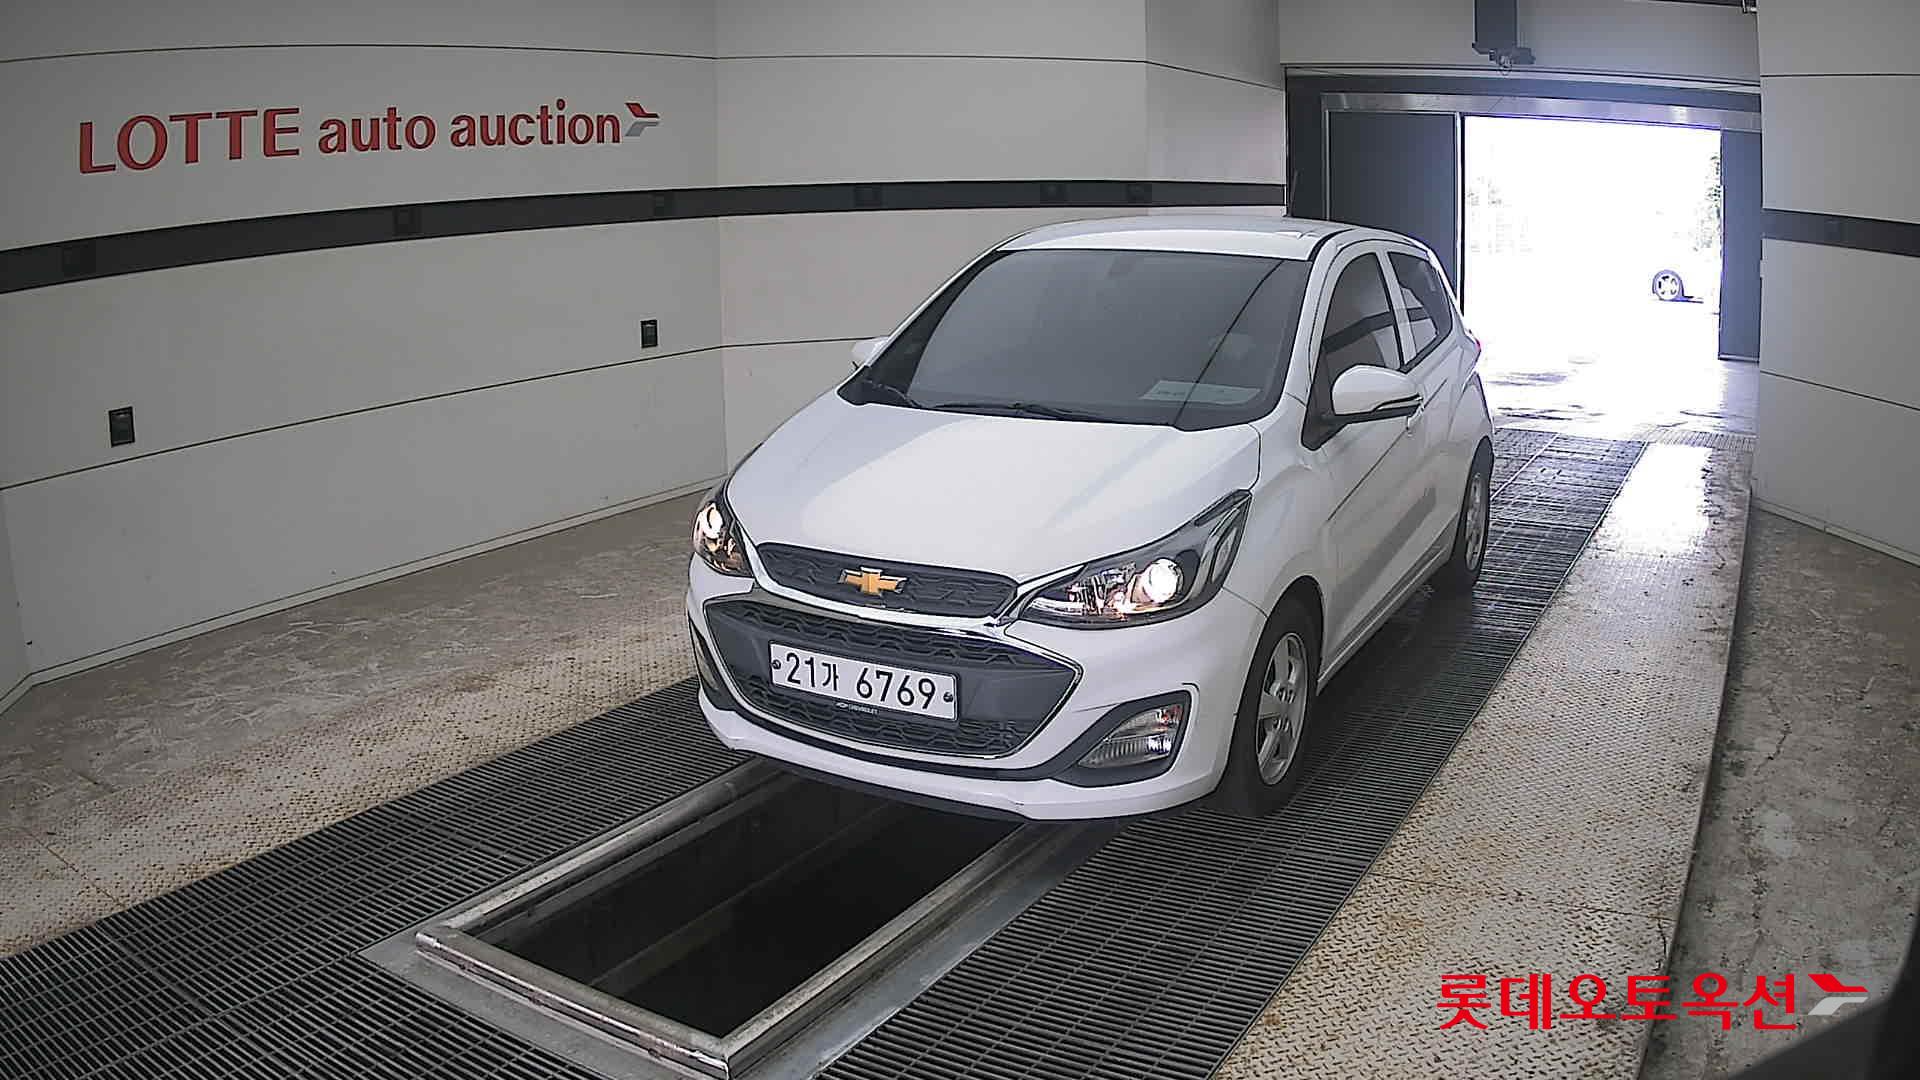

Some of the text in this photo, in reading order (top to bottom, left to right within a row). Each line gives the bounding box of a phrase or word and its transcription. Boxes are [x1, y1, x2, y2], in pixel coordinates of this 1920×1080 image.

[79, 99, 622, 174] LOTTE auto auction
[785, 652, 937, 710] 21가 6769
